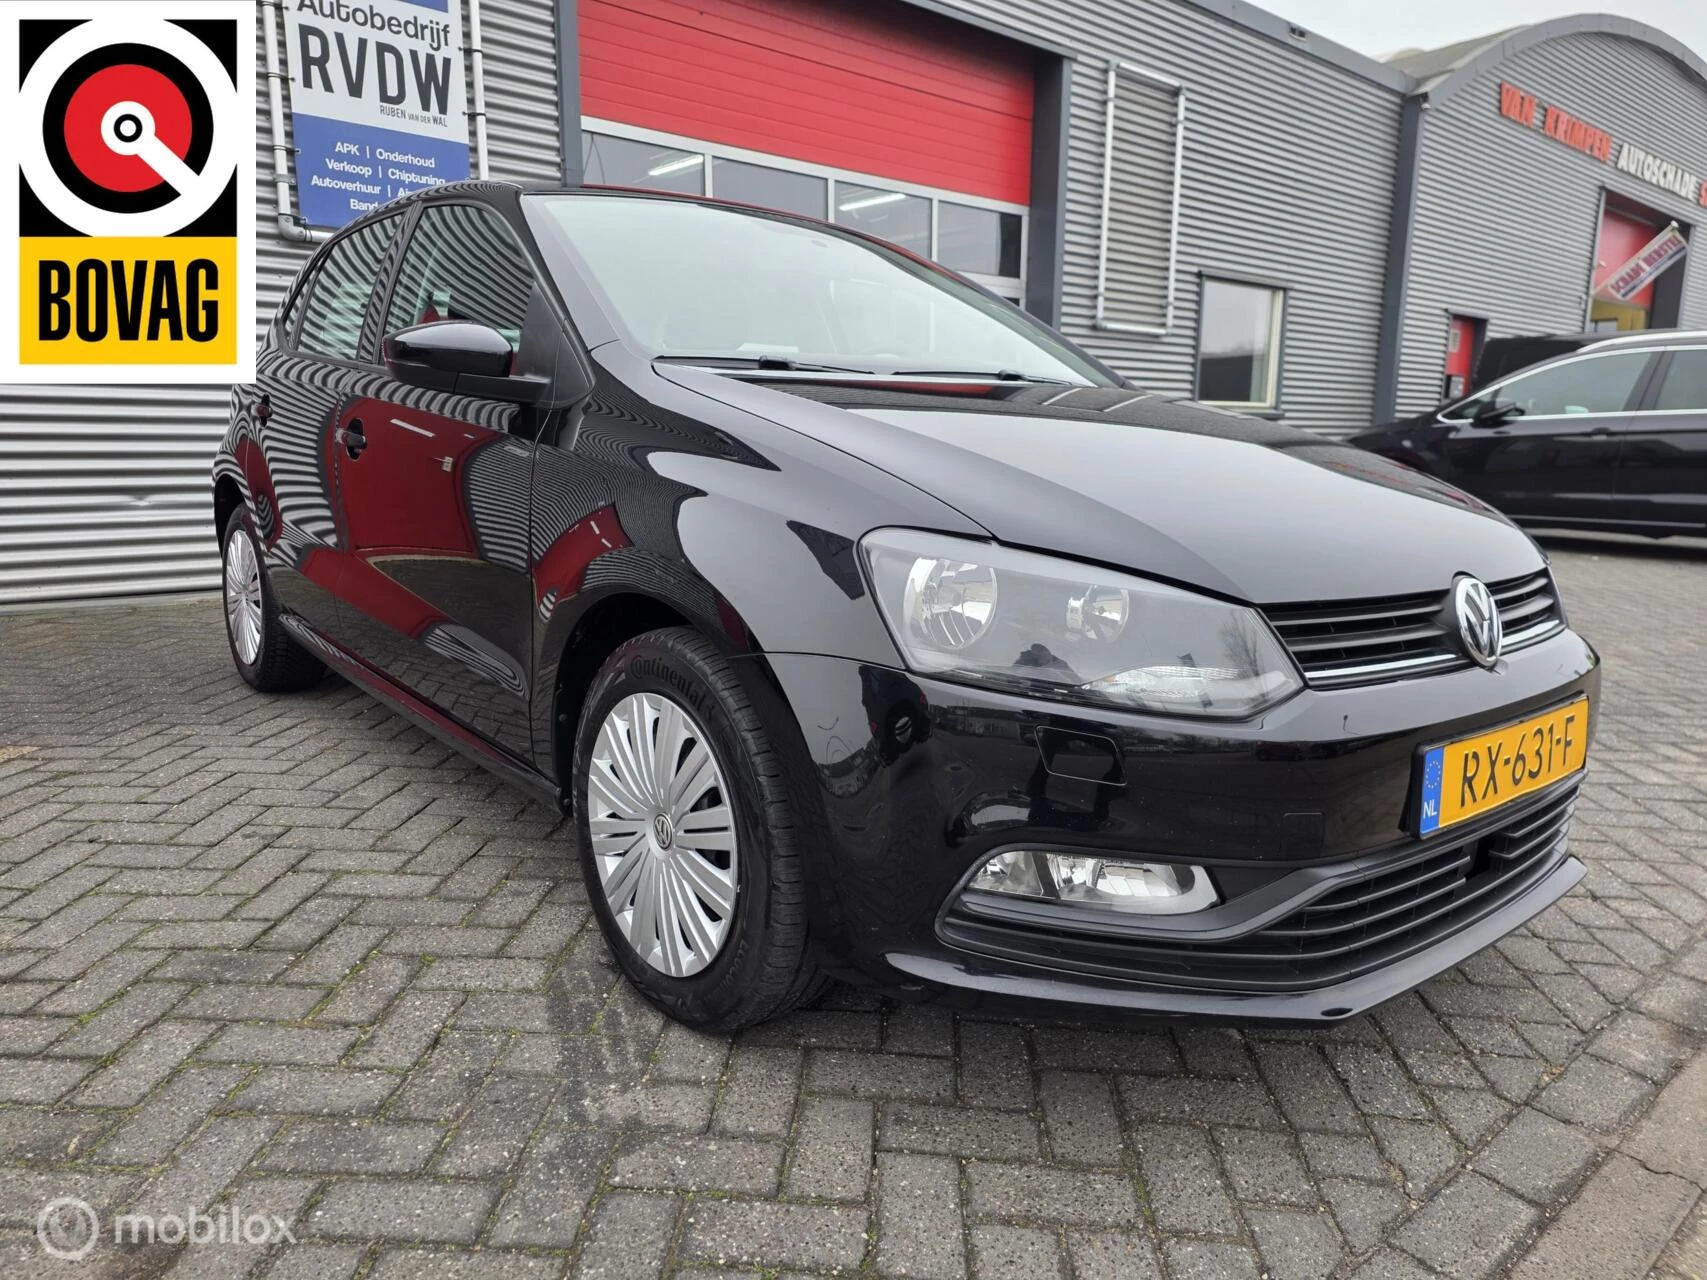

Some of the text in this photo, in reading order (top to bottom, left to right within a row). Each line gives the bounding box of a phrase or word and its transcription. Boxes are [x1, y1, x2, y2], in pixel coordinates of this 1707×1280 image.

[298, 23, 452, 116] RVDW
[379, 104, 448, 128] RUBEN VAN DER WAL
[334, 142, 436, 168] APK Onderhoud
[1500, 80, 1537, 129] VAN
[1543, 104, 1613, 163] KRIMPEN
[1616, 142, 1698, 202] AUTOSCHADE
[311, 175, 382, 195] Autoverhuur
[325, 158, 446, 187] Verkoop Chiptuning
[630, 654, 707, 712] Continental
[1460, 715, 1576, 809] RX-631-F
[1423, 799, 1438, 819] NL
